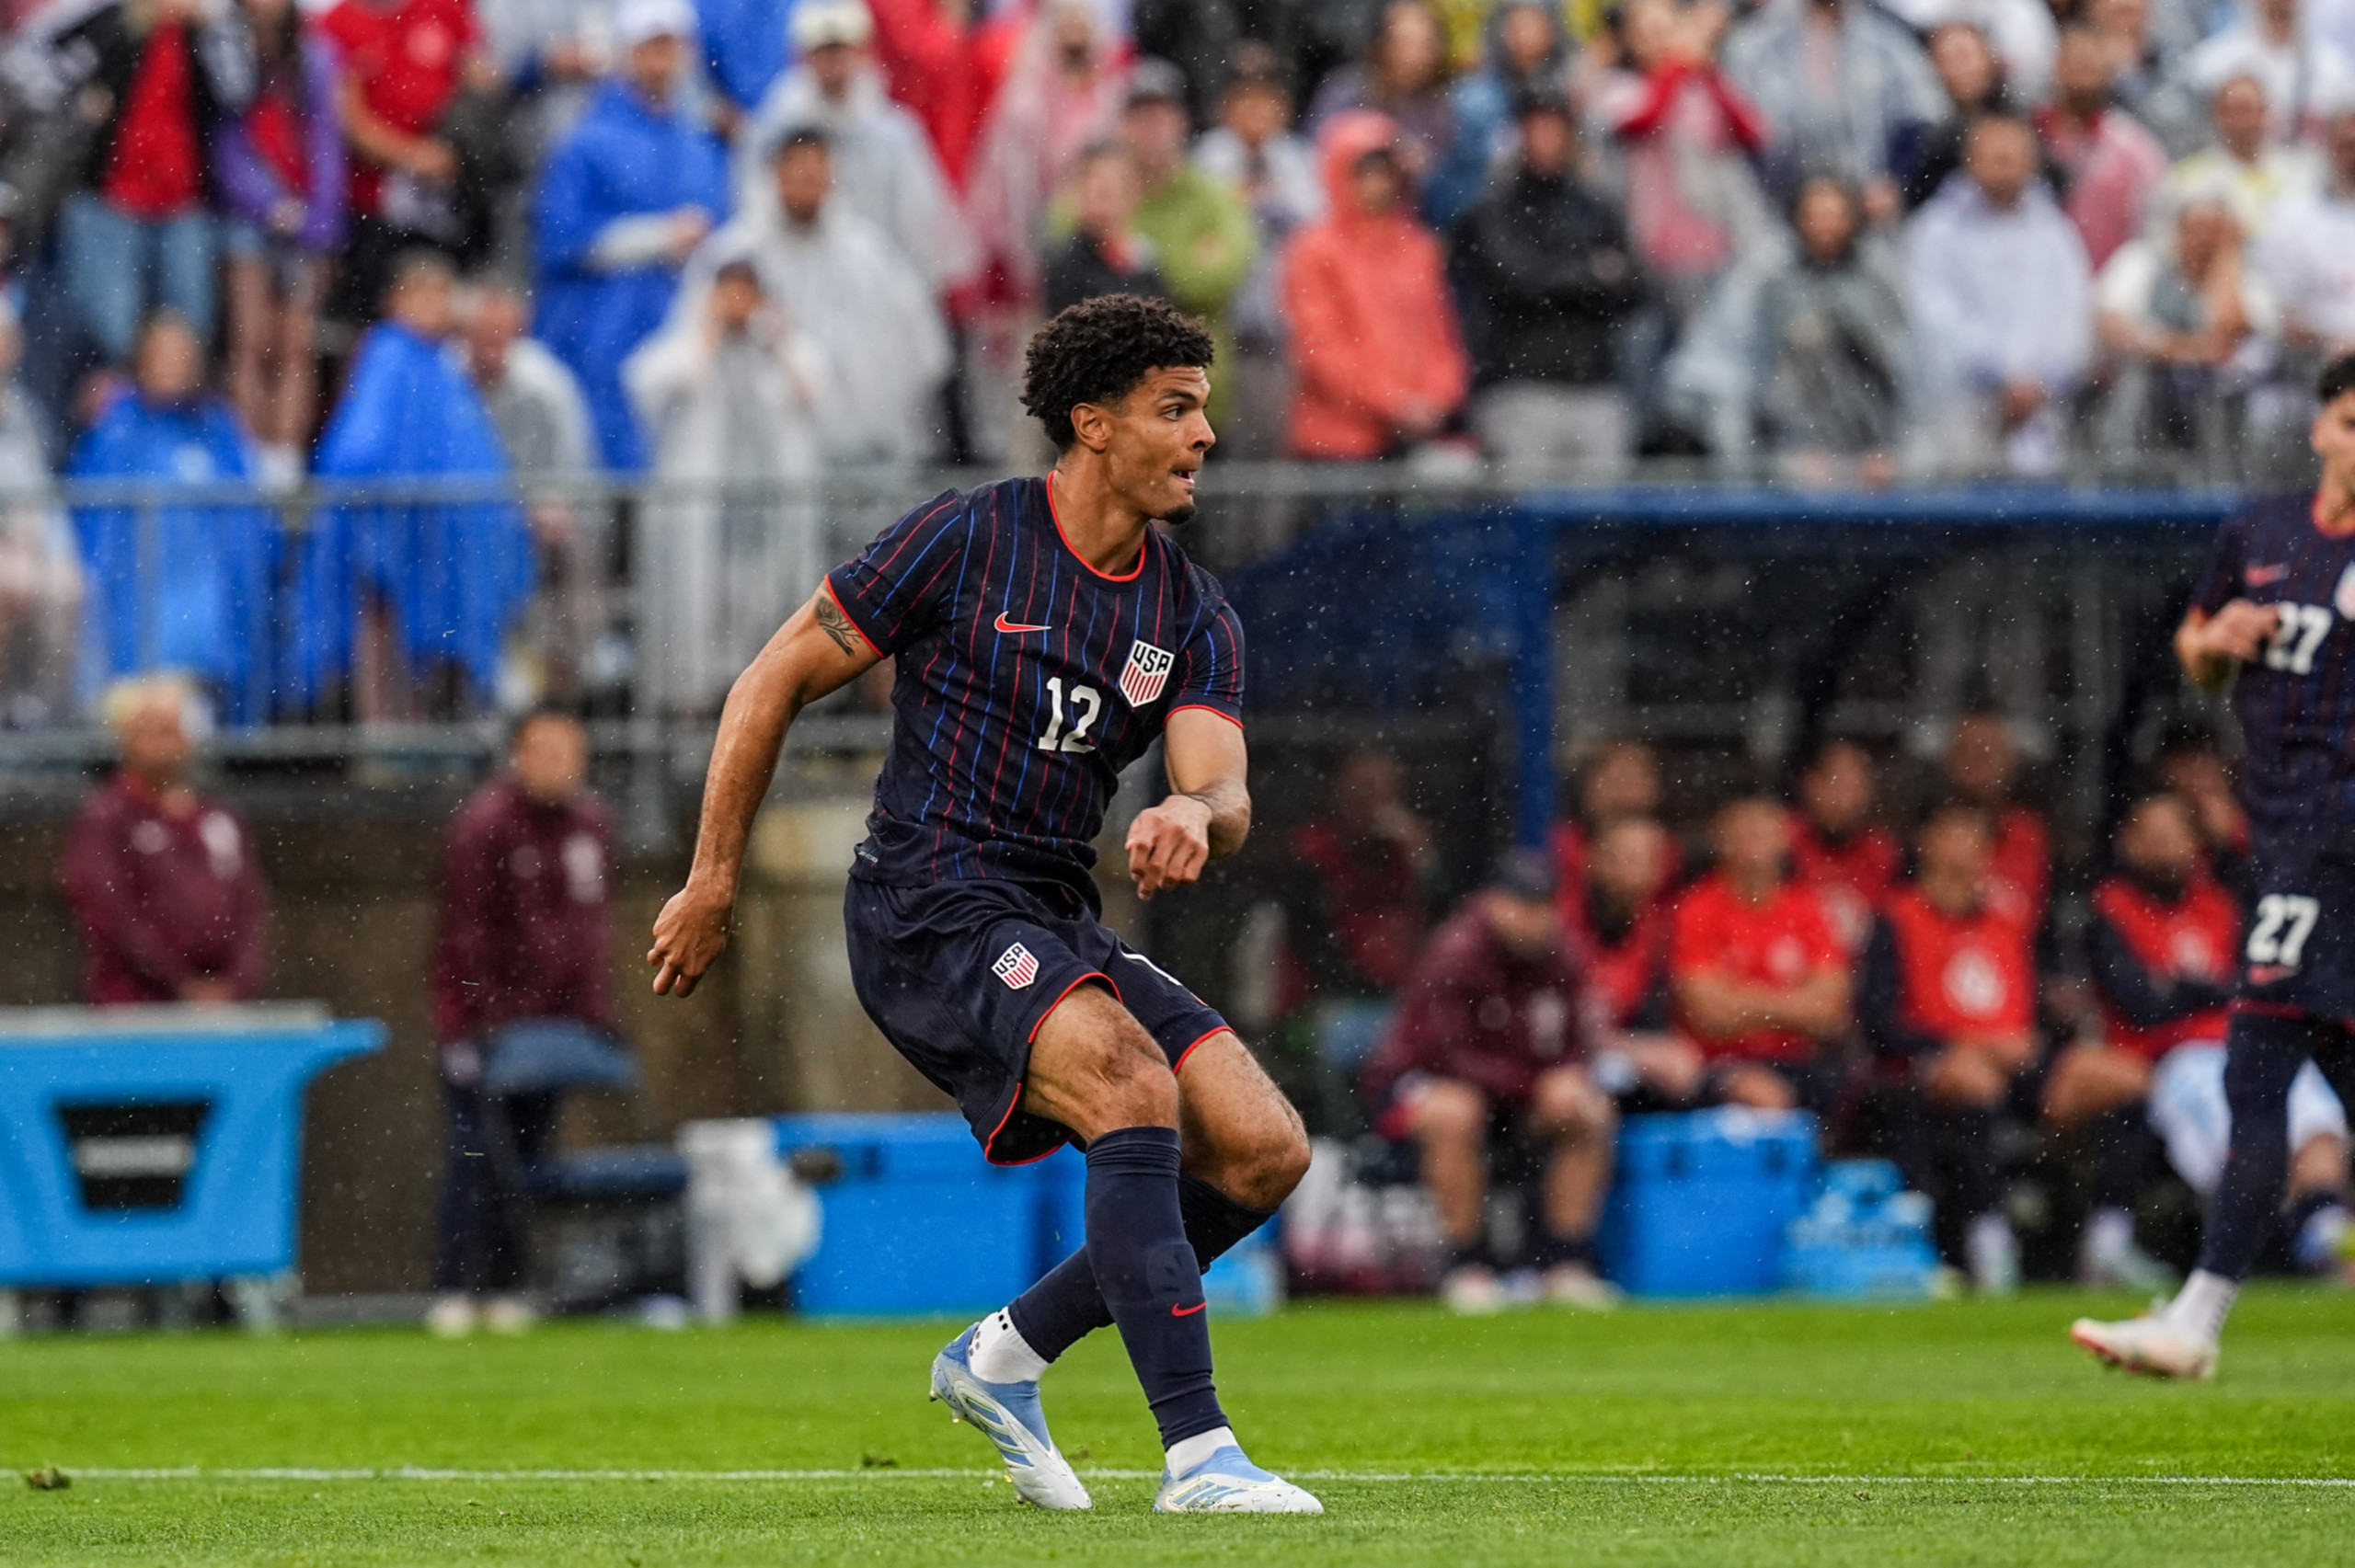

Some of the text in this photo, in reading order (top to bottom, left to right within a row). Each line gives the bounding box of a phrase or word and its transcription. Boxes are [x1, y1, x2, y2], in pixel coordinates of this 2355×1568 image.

[1132, 644, 1171, 673] USA
[1038, 676, 1102, 753] 12
[2246, 893, 2320, 967] 27
[995, 945, 1024, 975] USA
